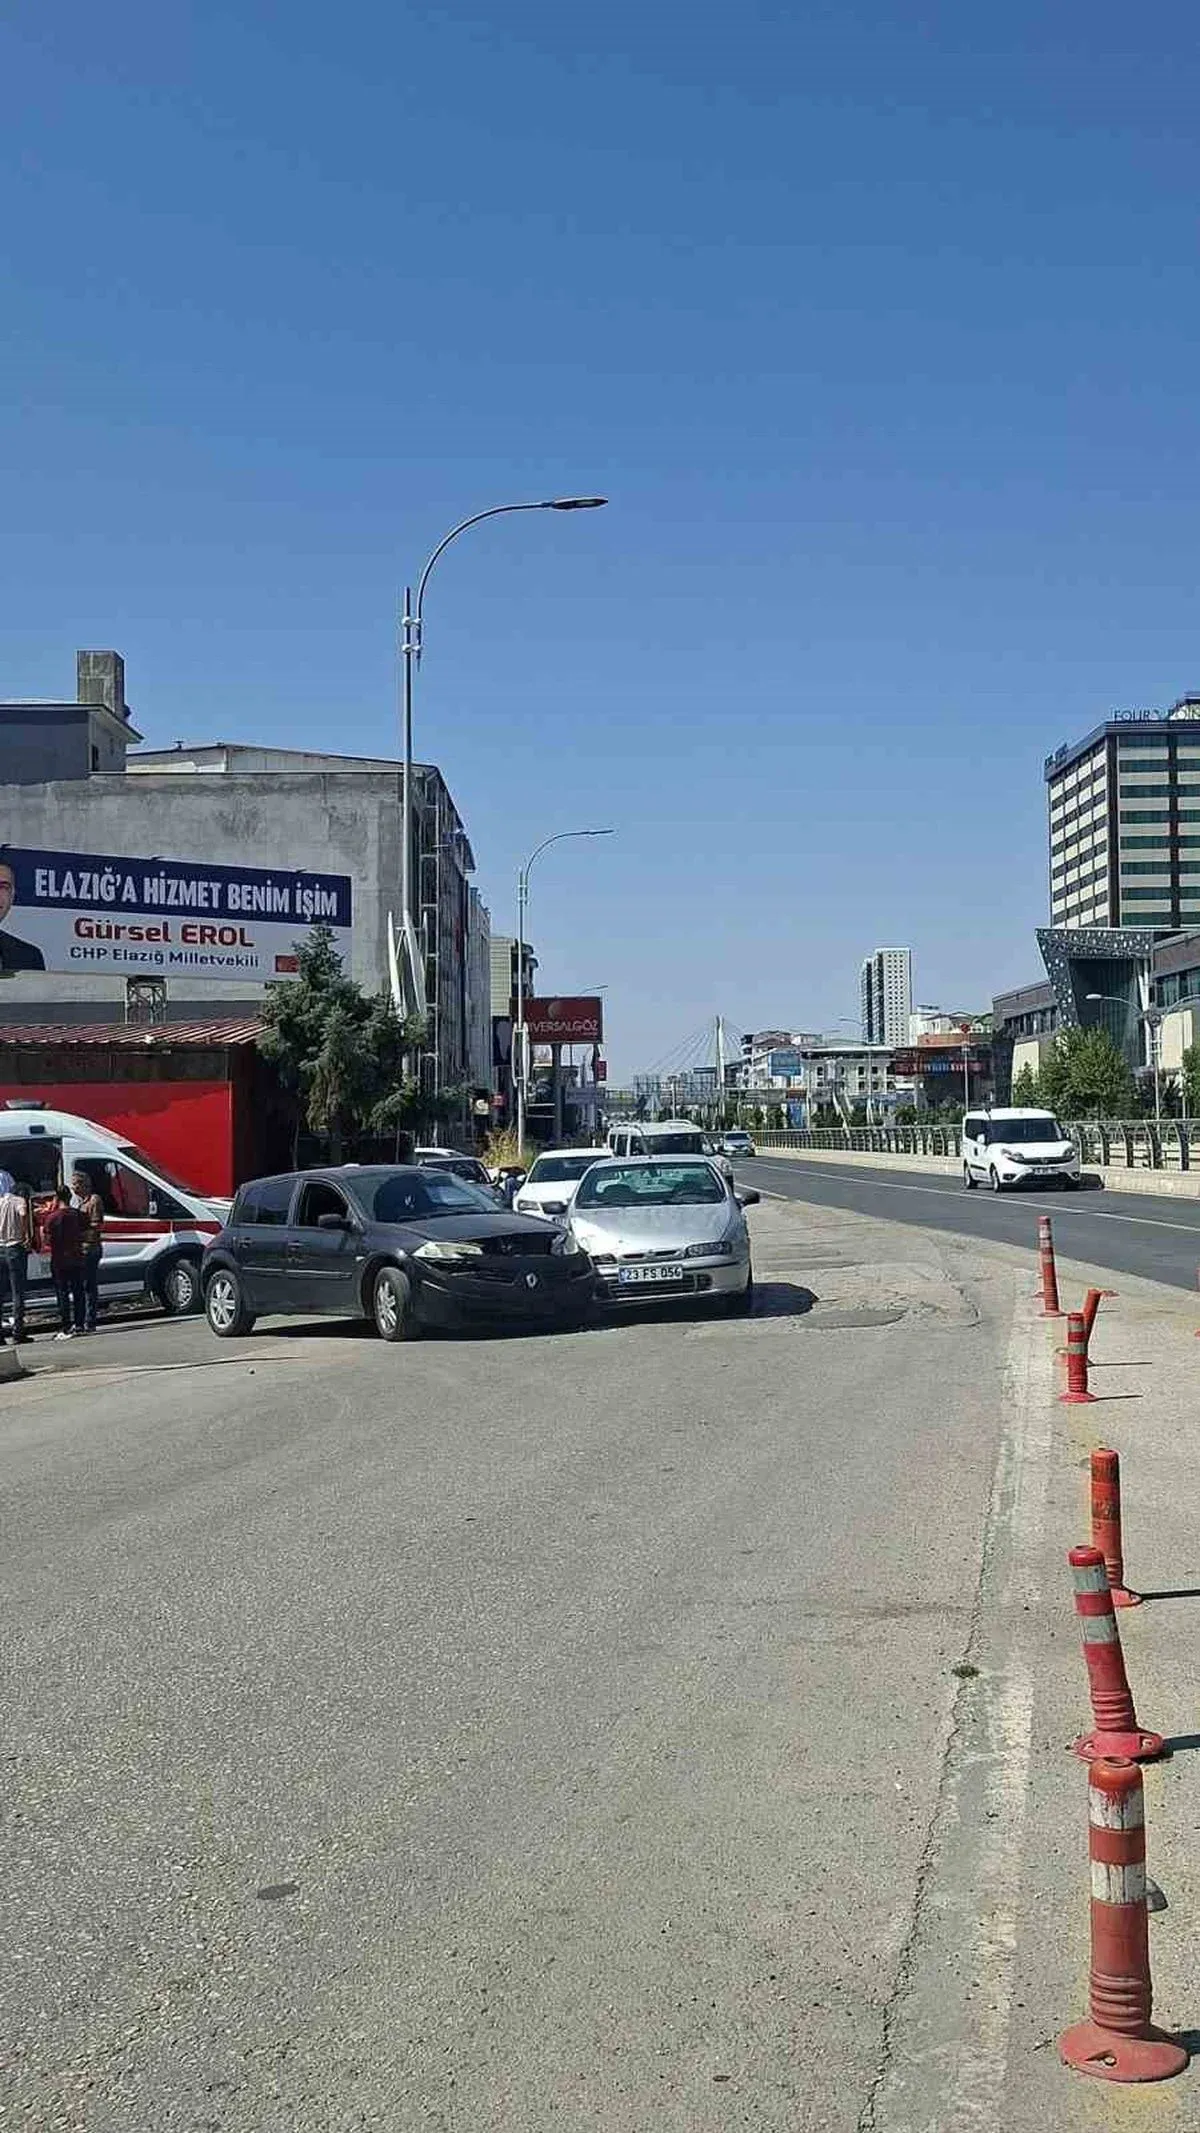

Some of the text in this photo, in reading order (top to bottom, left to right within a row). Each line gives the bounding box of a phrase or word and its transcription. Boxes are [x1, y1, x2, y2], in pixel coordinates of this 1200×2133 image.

[34, 867, 338, 920] ELAZIĞ'A HİZMET BENİM İŞİM
[74, 917, 255, 947] Gürsel EROL
[70, 946, 259, 968] CHP Elazığ Milletvekili
[626, 1270, 639, 1280] 23
[643, 1268, 657, 1279] FS
